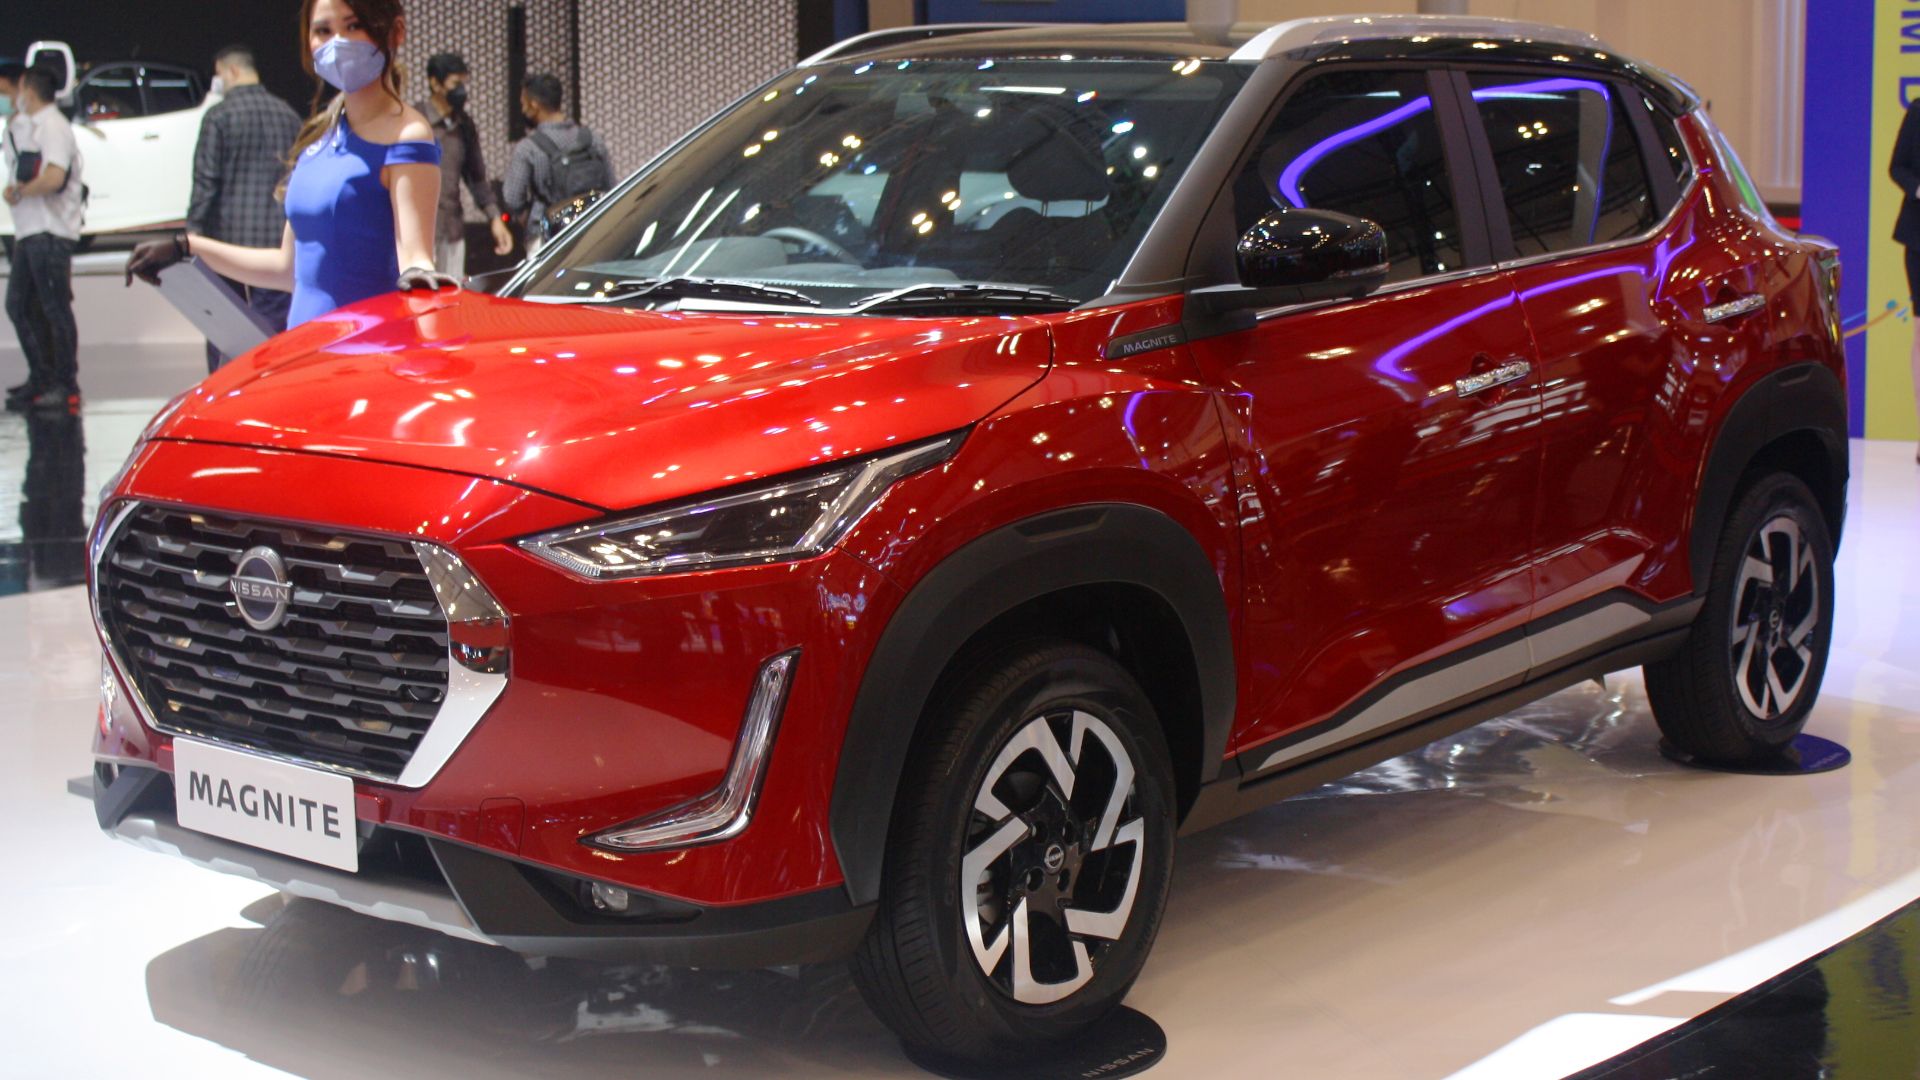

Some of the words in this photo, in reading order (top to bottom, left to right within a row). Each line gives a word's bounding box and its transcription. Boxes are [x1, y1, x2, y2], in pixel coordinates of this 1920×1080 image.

[1123, 334, 1177, 353] MAGNITE
[230, 578, 288, 601] NISSAN
[189, 769, 341, 839] MAGNITE
[1082, 1048, 1155, 1078] NISSAN
